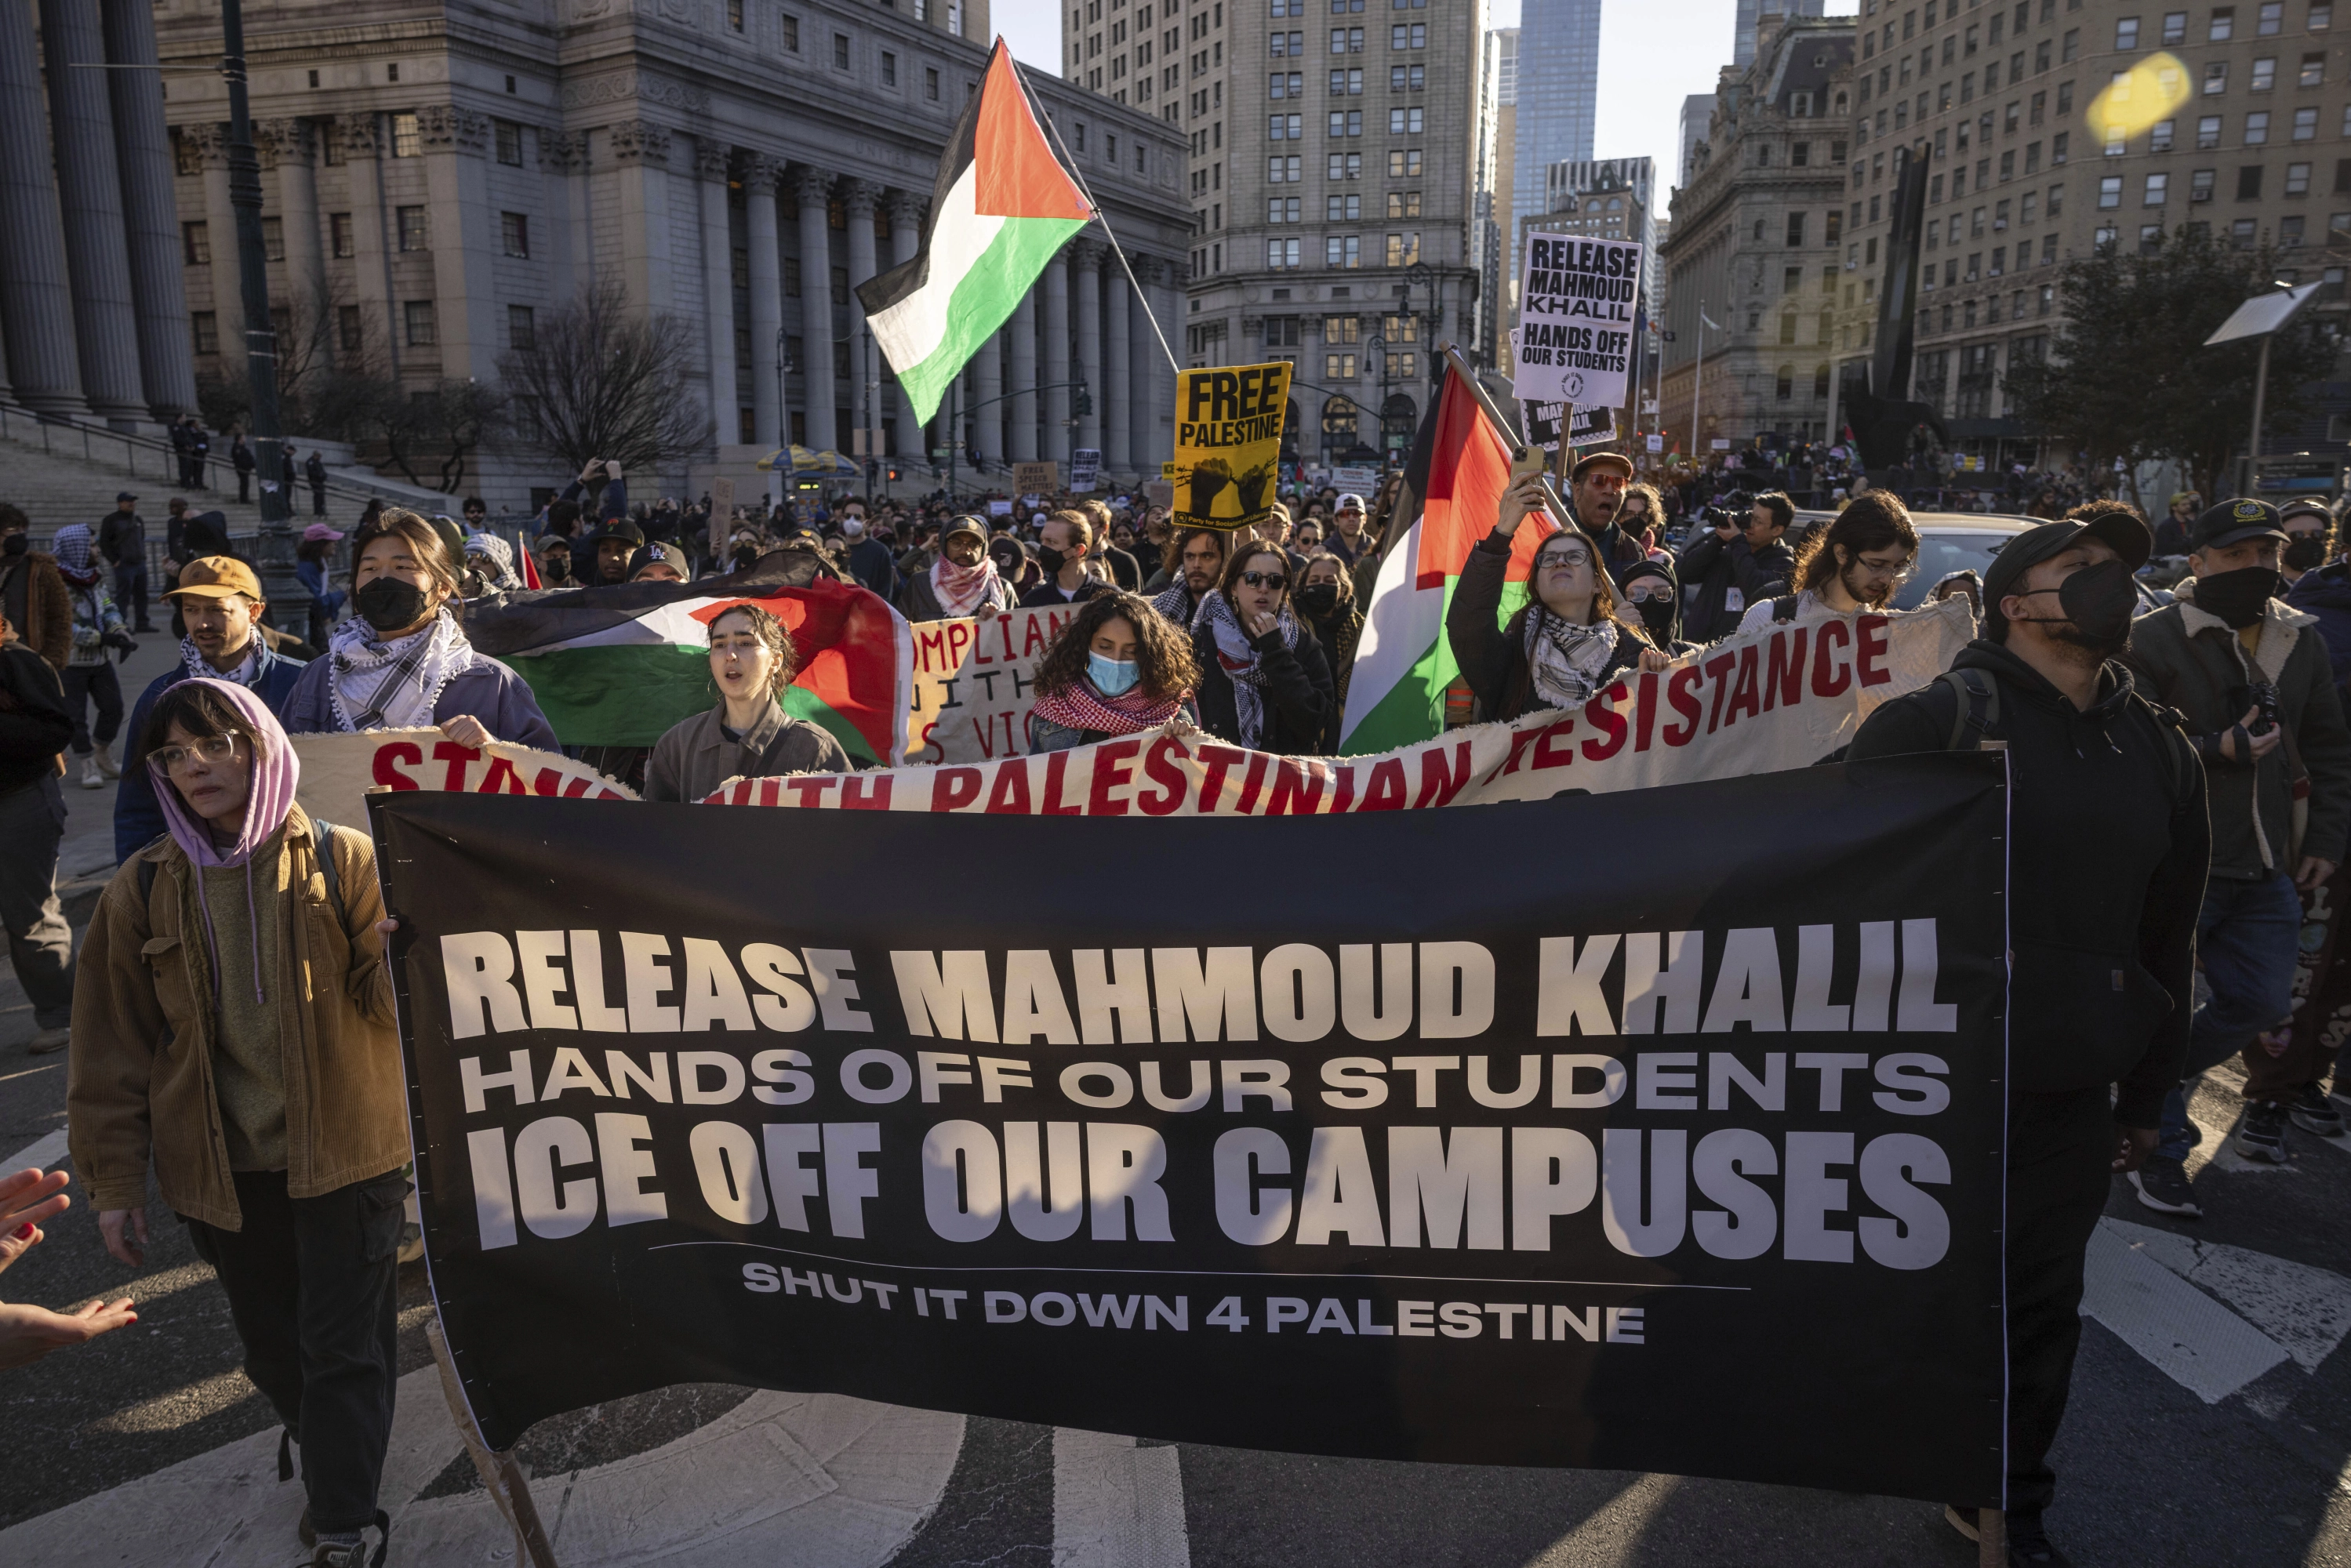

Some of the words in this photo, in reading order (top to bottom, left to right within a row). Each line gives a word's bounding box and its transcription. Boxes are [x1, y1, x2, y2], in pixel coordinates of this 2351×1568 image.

[1532, 238, 1638, 279] RELEASE
[1528, 269, 1635, 303] MAHMOUD
[1526, 295, 1631, 322] KHALIL
[1524, 322, 1593, 350] HANDS
[1596, 329, 1630, 355] OFF
[1521, 347, 1553, 366] OUR
[1556, 349, 1626, 373] STUDENTS
[1188, 366, 1282, 423] FREE
[1179, 412, 1281, 448] PALESTINE
[1550, 413, 1593, 435] KALIL
[1188, 517, 1205, 525] Party
[930, 734, 1473, 815] PALESTINIAN
[440, 930, 874, 1040] RELEASE
[889, 941, 1496, 1045] MAHMOUD
[1536, 917, 1958, 1037] KHALIL
[460, 1047, 816, 1114] HANDS
[839, 1049, 1034, 1104] OFF
[1059, 1059, 1294, 1112] OUR
[1320, 1051, 1951, 1116] STUDENTS
[467, 1112, 668, 1251] ICE
[689, 1120, 881, 1240] OFF
[921, 1120, 1176, 1243] OUR
[1213, 1126, 1952, 1271] CAMPUSES
[742, 1262, 899, 1311] SHUT
[914, 1287, 968, 1320] IT
[983, 1290, 1190, 1331] DOWN
[1205, 1296, 1250, 1334] 4
[1266, 1297, 1645, 1345] PALESTINE
